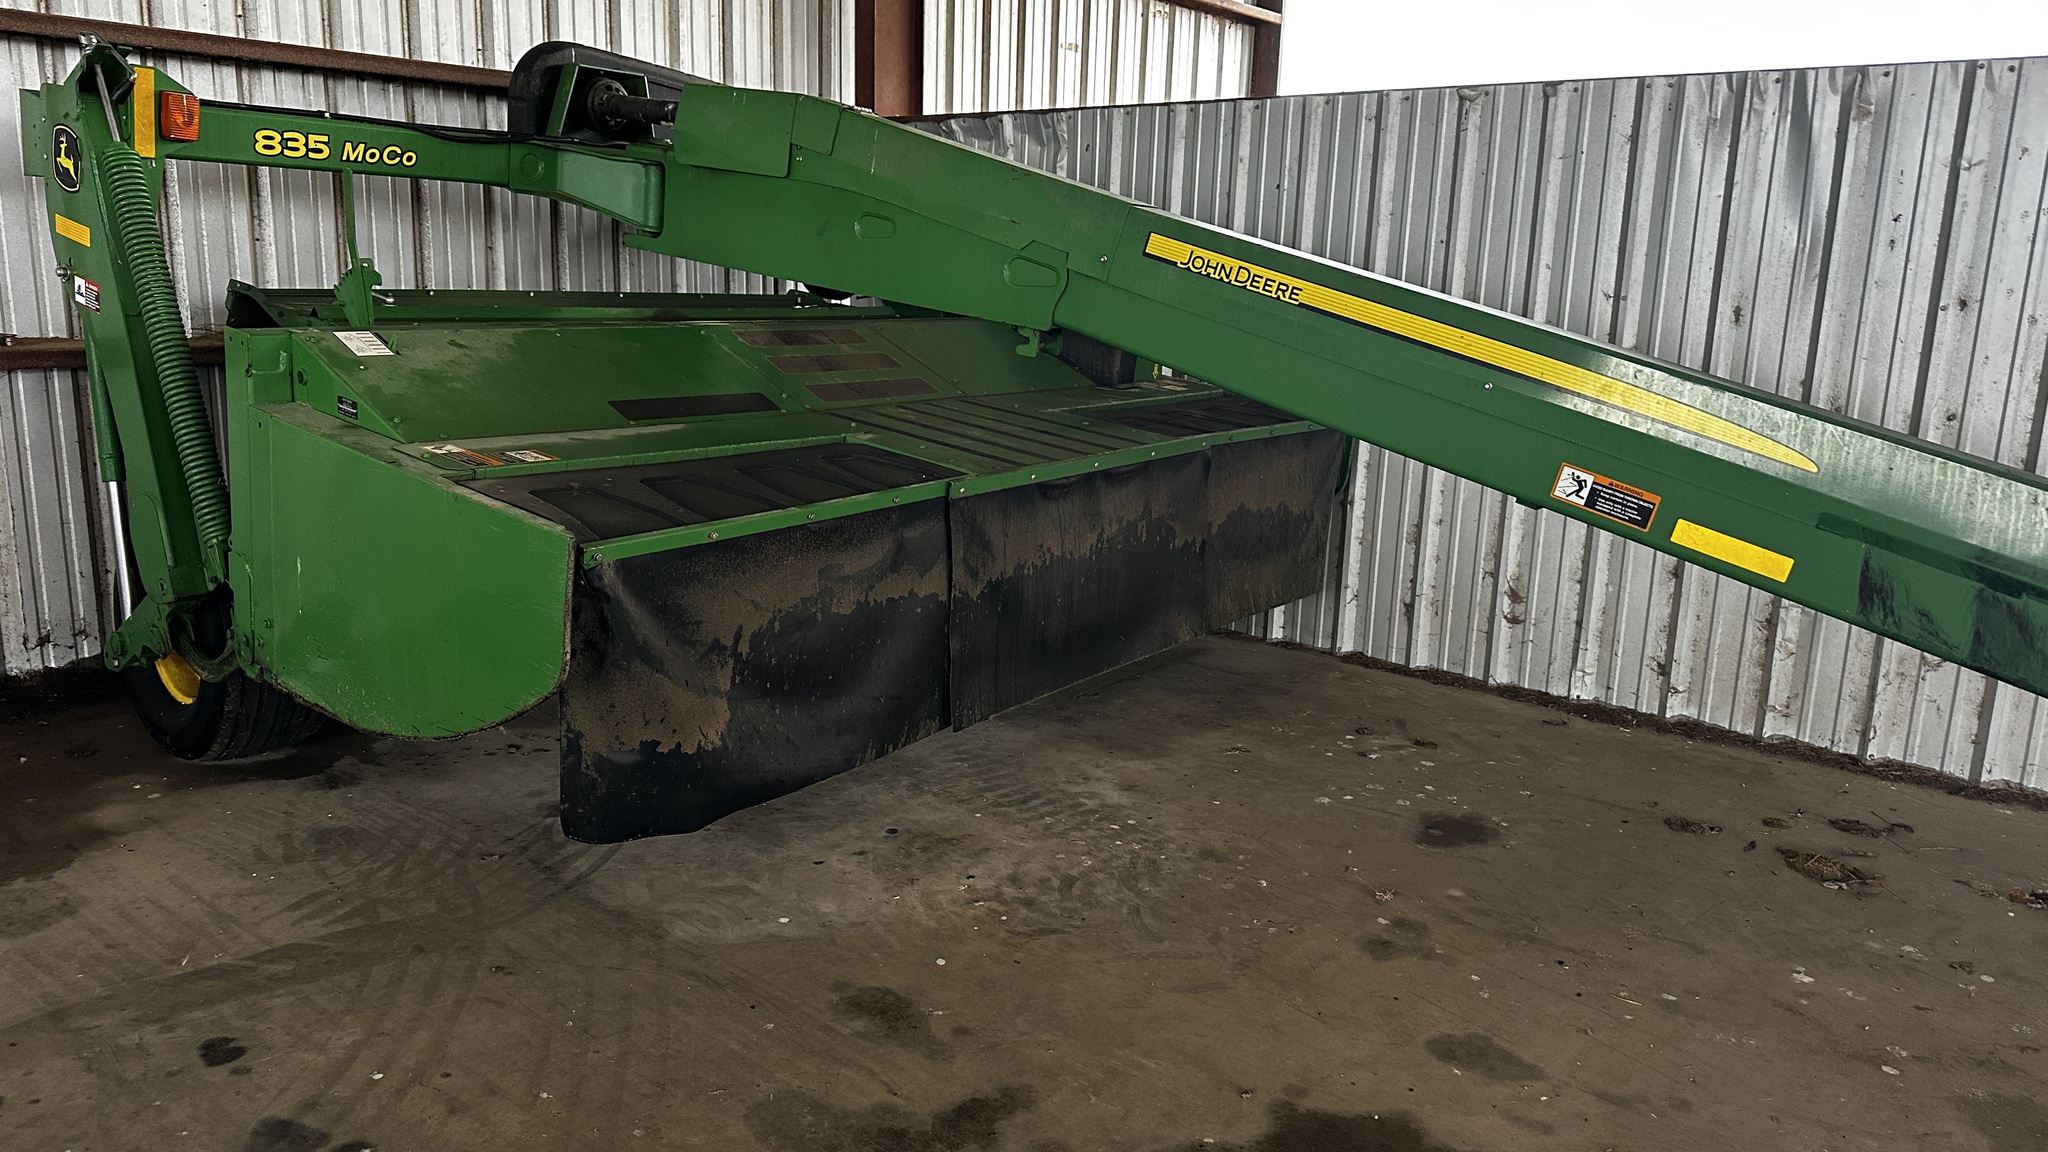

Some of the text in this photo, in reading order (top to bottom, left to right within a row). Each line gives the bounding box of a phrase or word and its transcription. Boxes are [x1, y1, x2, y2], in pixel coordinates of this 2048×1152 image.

[254, 128, 418, 167] 835 MoCo
[1179, 250, 1303, 303] JOHN DEERE
[1613, 482, 1644, 497] WARNING
